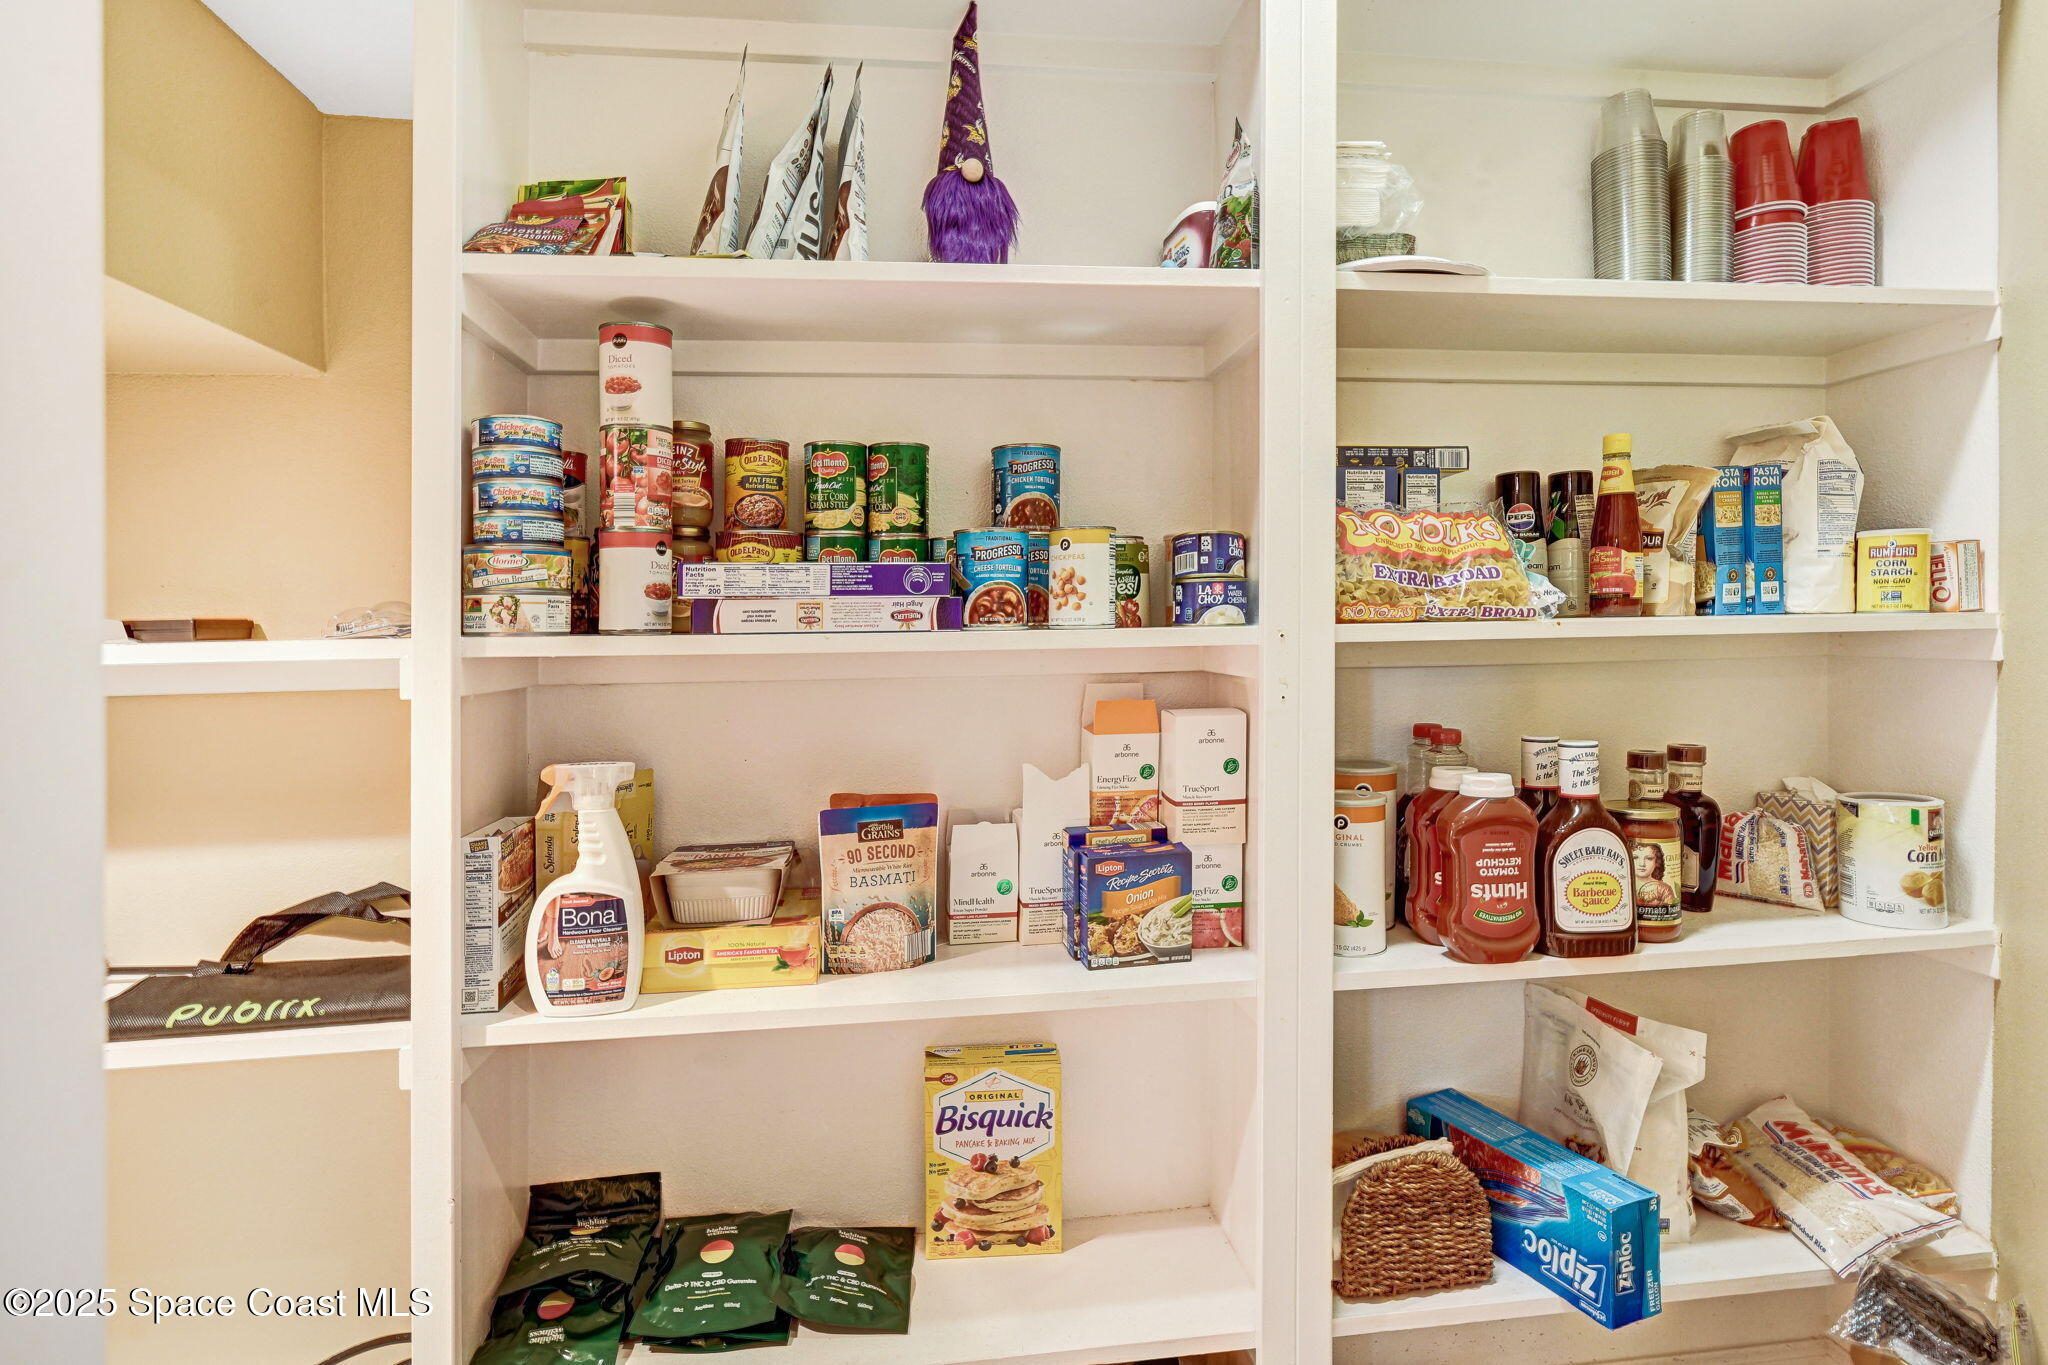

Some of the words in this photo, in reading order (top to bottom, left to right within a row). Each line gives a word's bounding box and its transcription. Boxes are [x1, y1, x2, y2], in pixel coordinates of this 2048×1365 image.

[608, 354, 632, 363] Diced
[532, 424, 546, 433] Sea
[744, 455, 757, 465] OLD
[767, 455, 782, 466] PASO
[812, 458, 823, 467] Del
[823, 459, 846, 467] Monte
[1012, 459, 1054, 474] PROGRESSO
[1753, 467, 1780, 476] PASTA
[1011, 475, 1033, 484] CHICKEN
[1034, 476, 1055, 485] TORTILLA
[1715, 477, 1741, 487] RONI
[1753, 476, 1780, 486] RONI
[531, 489, 545, 497] Sea
[810, 493, 828, 501] SWEET
[829, 493, 849, 501] CORN
[810, 501, 830, 509] CREAM
[830, 501, 849, 509] STYLE
[874, 503, 893, 511] CORN
[1508, 513, 1534, 521] PEPSI
[1339, 511, 1400, 537] NO
[1405, 512, 1503, 547] YOLKS
[1228, 537, 1238, 547] LA
[1375, 537, 1413, 549] ENRICHED
[1448, 541, 1486, 554] PRODUCT
[730, 548, 742, 557] OLD
[752, 547, 770, 557] PASO
[975, 544, 1022, 561] PROGRESSO
[1870, 546, 1916, 558] RUMFORD
[493, 556, 524, 565] Hormel
[831, 555, 855, 563] Monte
[890, 555, 915, 563] Monte
[1875, 559, 1908, 568] CORN
[650, 561, 670, 570] Diced
[973, 564, 994, 573] CHEESE
[995, 564, 1022, 573] TORTELLINI
[1373, 564, 1430, 588] EXTRA
[1433, 565, 1502, 589] BROAD
[1870, 568, 1913, 577] STARCH
[481, 575, 509, 587] Chicken
[511, 574, 534, 583] Breast
[1116, 575, 1139, 595] es!
[1198, 584, 1211, 595] LA
[1198, 594, 1225, 605] CHOY
[1344, 604, 1367, 618] NO
[1368, 605, 1414, 619] YOLKS
[1425, 605, 1477, 618] EXTRA
[1481, 607, 1537, 619] BROAD
[1533, 745, 1548, 758] SWEET
[1569, 753, 1584, 765] SWEET
[1535, 761, 1548, 771] The
[1535, 772, 1542, 781] is
[1542, 771, 1554, 780] the
[1571, 769, 1585, 778] The
[1096, 775, 1137, 784] EnergyFizz
[1571, 779, 1578, 788] is
[1578, 778, 1591, 787] the
[1182, 785, 1220, 794] TrueSport
[861, 828, 901, 841] GRAINS
[543, 836, 555, 873] Splenda
[694, 852, 745, 860] RAMEN
[846, 849, 862, 864] 90
[867, 844, 916, 860] SECOND
[1558, 848, 1583, 869] SWEET
[1585, 845, 1607, 857] BABY
[1607, 849, 1625, 867] RAY'S
[1907, 849, 1938, 863] Corn
[1475, 856, 1522, 867] KETCHUP
[852, 866, 886, 874] Microwavable
[1097, 864, 1123, 875] Lipton
[1479, 867, 1519, 876] TOMATO
[850, 871, 916, 888] BASMATI
[1106, 874, 1140, 890] Recipe
[1139, 864, 1175, 883] Secrets
[1125, 888, 1154, 905] Onion
[1470, 881, 1529, 902] Hunt's
[1572, 887, 1617, 899] Barbecue
[953, 898, 995, 907] MindHealth
[1582, 896, 1610, 908] Sauce
[561, 908, 617, 927] Bona
[1479, 911, 1514, 922] PRESERVATIVES
[1513, 910, 1523, 919] NO
[667, 950, 701, 962] Lipton
[969, 1092, 1020, 1101] ORIGINAL
[935, 1102, 1053, 1137] Bisquick
[955, 1139, 985, 1148] PANCAKE
[987, 1138, 992, 1147] &
[994, 1138, 1020, 1147] BAKING
[1022, 1136, 1036, 1145] MIX
[706, 1226, 738, 1235] highline
[1812, 1237, 1828, 1253] Rice
[1523, 1229, 1599, 1300] Ziploc
[1616, 1231, 1633, 1292] Ziploc
[664, 1281, 689, 1292] Delta-9
[690, 1280, 704, 1288] THC
[805, 1274, 826, 1287] Delta-9
[826, 1275, 840, 1283] THC
[846, 1278, 859, 1286] CBD
[860, 1281, 888, 1296] Gummies
[1648, 1269, 1656, 1312] FREEZER
[829, 1296, 849, 1305] Anytime
[694, 1303, 715, 1311] Anytime
